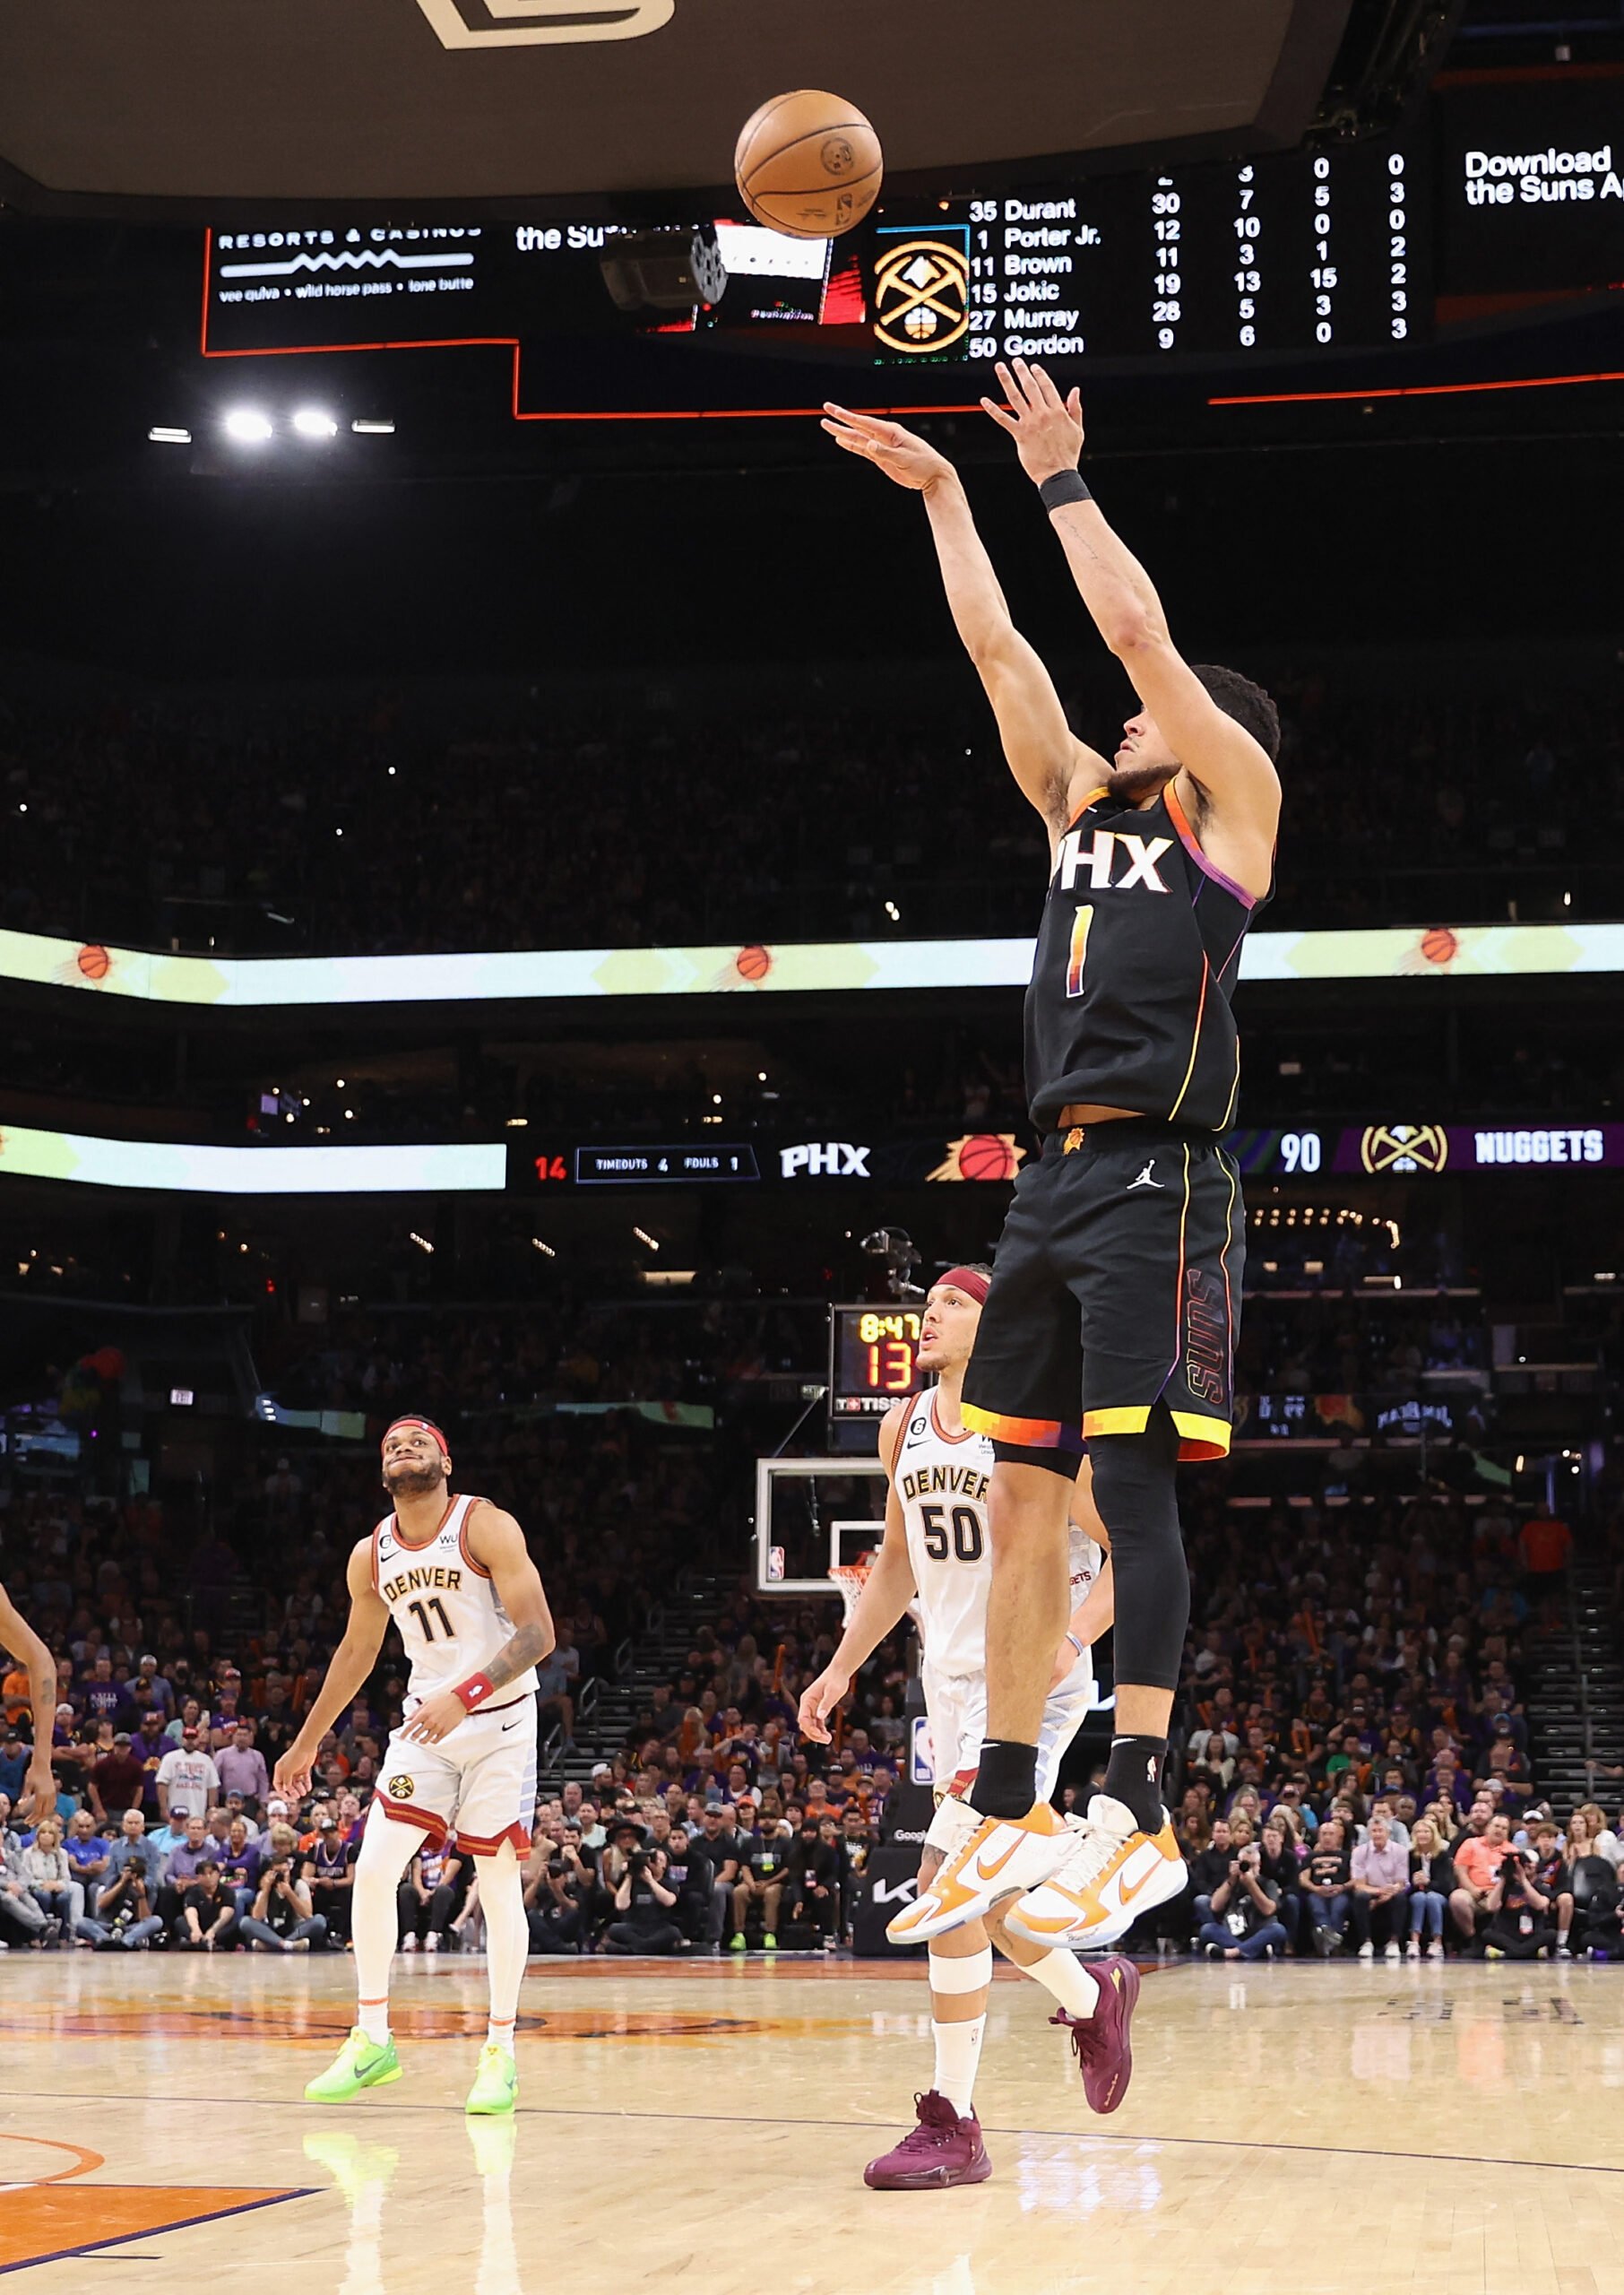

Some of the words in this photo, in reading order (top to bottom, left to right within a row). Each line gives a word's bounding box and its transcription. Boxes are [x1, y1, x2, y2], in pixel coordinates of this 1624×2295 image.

[1314, 158, 1329, 178] 0
[1388, 154, 1404, 175] 0
[1465, 145, 1615, 178] Download
[970, 201, 997, 222] 35
[1005, 198, 1075, 221] Durant
[1153, 193, 1180, 213] 30
[1240, 190, 1253, 210] 7
[1315, 186, 1329, 206] 5
[1390, 182, 1404, 203] 3
[1465, 177, 1514, 204] the
[1520, 174, 1594, 202] Suns
[219, 230, 333, 249] RESORTS
[346, 229, 360, 242] &
[516, 227, 561, 251] the
[978, 230, 987, 249] 1
[1005, 228, 1071, 248] Porter
[1075, 225, 1101, 245] Jr.
[1154, 220, 1180, 240] 12
[1234, 217, 1260, 238] 10
[1315, 213, 1330, 234] 0
[1389, 209, 1405, 230] 0
[971, 256, 993, 277] 11
[1005, 255, 1072, 275] Brown
[1156, 247, 1177, 267] 11
[1240, 244, 1254, 264] 3
[1317, 240, 1326, 261] 1
[1391, 236, 1405, 256] 2
[219, 290, 243, 303] vee
[295, 282, 323, 299] wild
[325, 282, 360, 297] horse
[361, 281, 393, 297] pass
[408, 279, 436, 293] lone
[972, 283, 997, 303] 15
[1004, 281, 1059, 302] Jokic
[1154, 273, 1180, 294] 19
[1234, 271, 1260, 291] 13
[1310, 267, 1337, 288] 15
[1391, 264, 1406, 283] 2
[968, 307, 996, 331] 27
[1005, 308, 1079, 331] Murray
[1153, 300, 1180, 321] 28
[1240, 299, 1254, 318] 5
[1317, 295, 1331, 316] 3
[1392, 290, 1406, 311] 3
[969, 337, 997, 358] 50
[1004, 334, 1084, 356] Gordon
[1159, 328, 1173, 349] 9
[1240, 325, 1255, 346] 6
[1317, 322, 1331, 342] 0
[1392, 318, 1407, 339] 3
[1052, 828, 1175, 893] HX
[1066, 904, 1094, 998] 1
[597, 1158, 647, 1170] TIMEOUTS
[658, 1158, 668, 1172] 4
[685, 1157, 719, 1168] FOULS
[730, 1156, 739, 1172] 1
[780, 1143, 870, 1177] PHX
[1281, 1133, 1320, 1172] 90
[1475, 1130, 1602, 1163] NUGGETS
[536, 1156, 566, 1180] 14
[860, 1313, 920, 1343] 8:47
[1187, 1269, 1225, 1405] SUNS
[868, 1341, 912, 1390] 13
[439, 1532, 458, 1545] WU
[919, 1503, 983, 1563] 50
[383, 1566, 462, 1603] DENVER
[1069, 1571, 1092, 1586] GETS
[408, 1597, 455, 1644] 11
[894, 1829, 928, 1844] Googl
